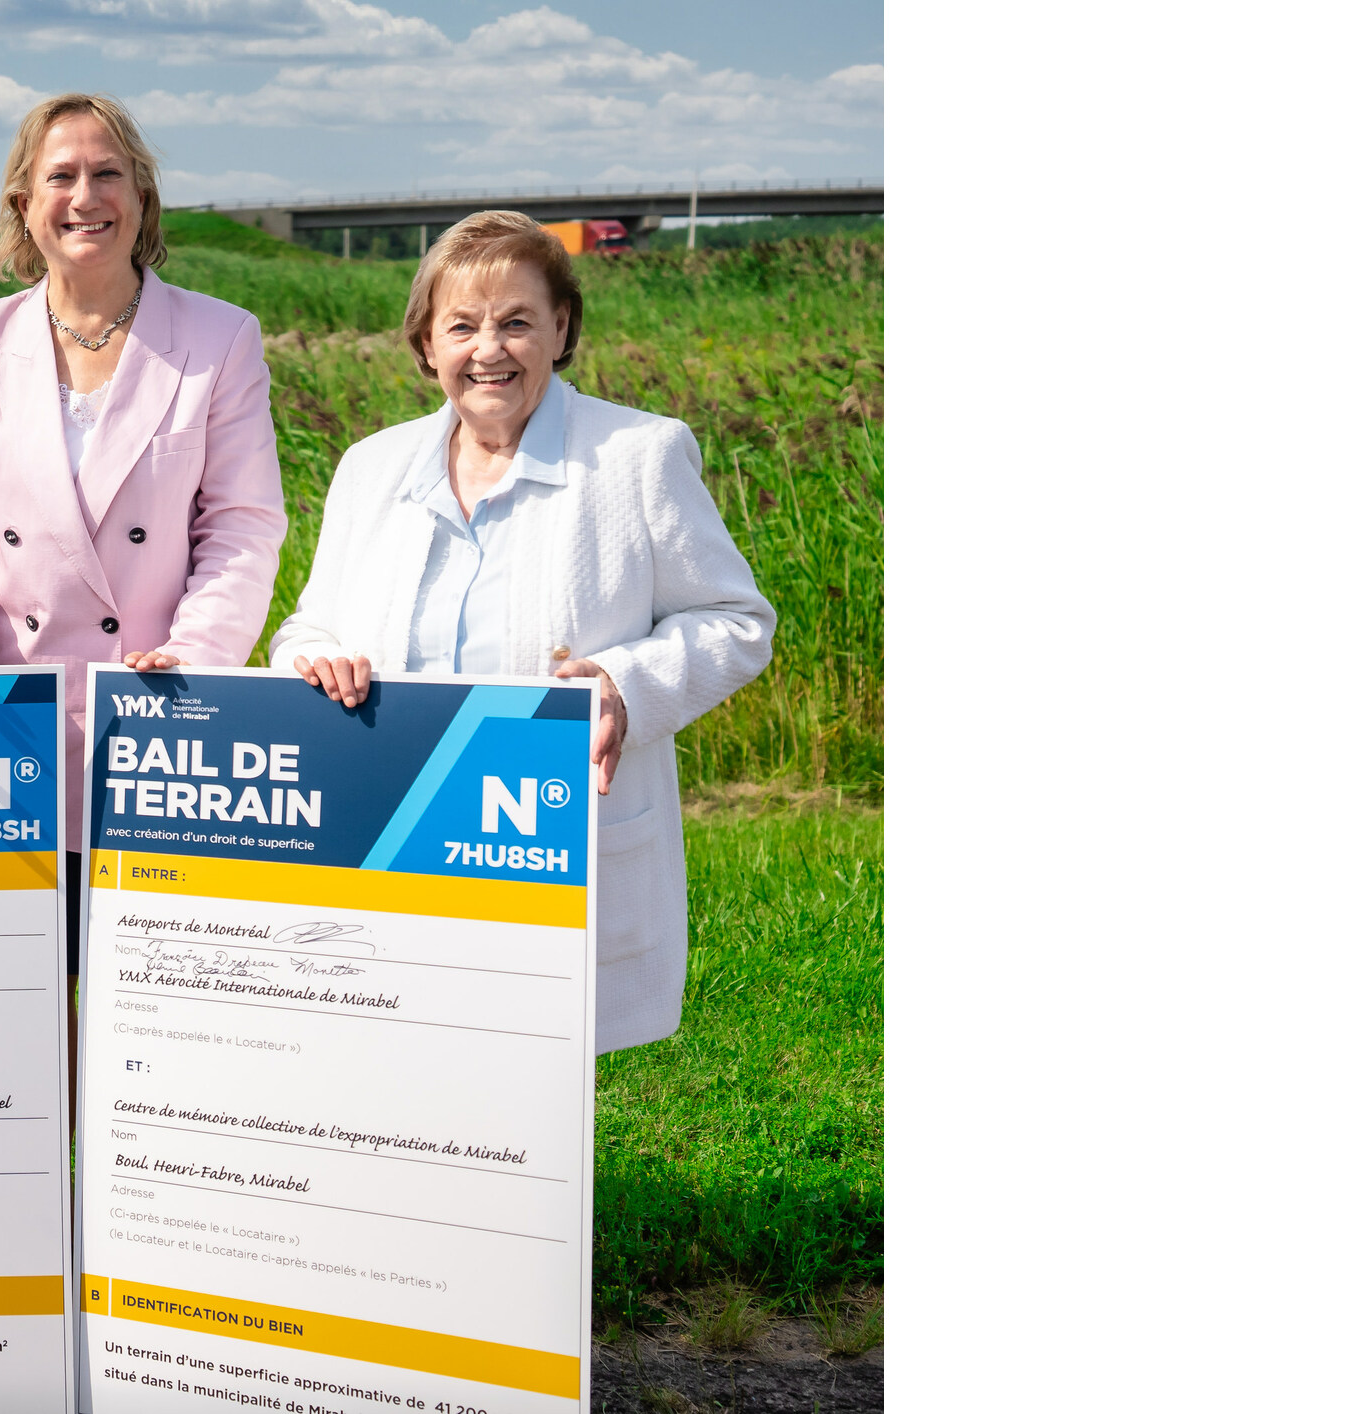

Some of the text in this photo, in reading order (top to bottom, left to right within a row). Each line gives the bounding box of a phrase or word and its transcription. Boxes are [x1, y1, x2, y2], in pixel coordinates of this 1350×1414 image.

[111, 694, 166, 719] YMX
[172, 704, 220, 713] Internationale
[108, 736, 299, 781] BAIL DE
[106, 778, 321, 827] TERRAIN
[106, 828, 131, 837] avec
[134, 829, 179, 840] création
[210, 833, 237, 845] droit
[240, 836, 255, 846] de
[258, 839, 314, 850] superficie
[444, 841, 568, 872] 7HU8SH
[99, 864, 109, 876] A
[132, 867, 178, 881] ENTRE
[117, 914, 182, 935] Aéroports
[184, 918, 203, 933] de
[204, 923, 271, 939] Montréal
[115, 944, 141, 955] Nom
[119, 969, 152, 984] YMX
[154, 973, 212, 989] Aérocité
[213, 979, 318, 1001] Internationale
[319, 988, 339, 1003] de
[340, 992, 400, 1009] Mirabel
[115, 999, 158, 1013] Adresse
[114, 1022, 287, 1051] (Ci-après appelée le Locateur
[126, 1060, 143, 1072] ET
[111, 1129, 137, 1141] Nom
[114, 1099, 158, 1115] Centre
[159, 1103, 177, 1118] de
[178, 1108, 240, 1126] mémoire
[241, 1115, 308, 1135] collective
[308, 1123, 328, 1138] de
[441, 1140, 462, 1155] de
[463, 1145, 527, 1164] Mirabel
[115, 1154, 310, 1192] Boul. Henri-Fabre, Mirabel
[111, 1184, 155, 1199] Adresse
[110, 1207, 286, 1243] (Ci-après appelée le Locataire
[91, 1289, 100, 1301] B
[123, 1294, 303, 1336] IDENTIFICATION DU BIEN
[105, 1341, 123, 1354] Un
[127, 1345, 171, 1363] terrain
[219, 1364, 289, 1385] superficie
[294, 1378, 401, 1405] approximative
[406, 1396, 425, 1410] de
[435, 1402, 450, 1414] 41
[104, 1367, 137, 1382] situé
[141, 1374, 173, 1389] dans
[178, 1379, 189, 1392] la
[194, 1385, 281, 1410] municipalité
[286, 1401, 304, 1414] de
